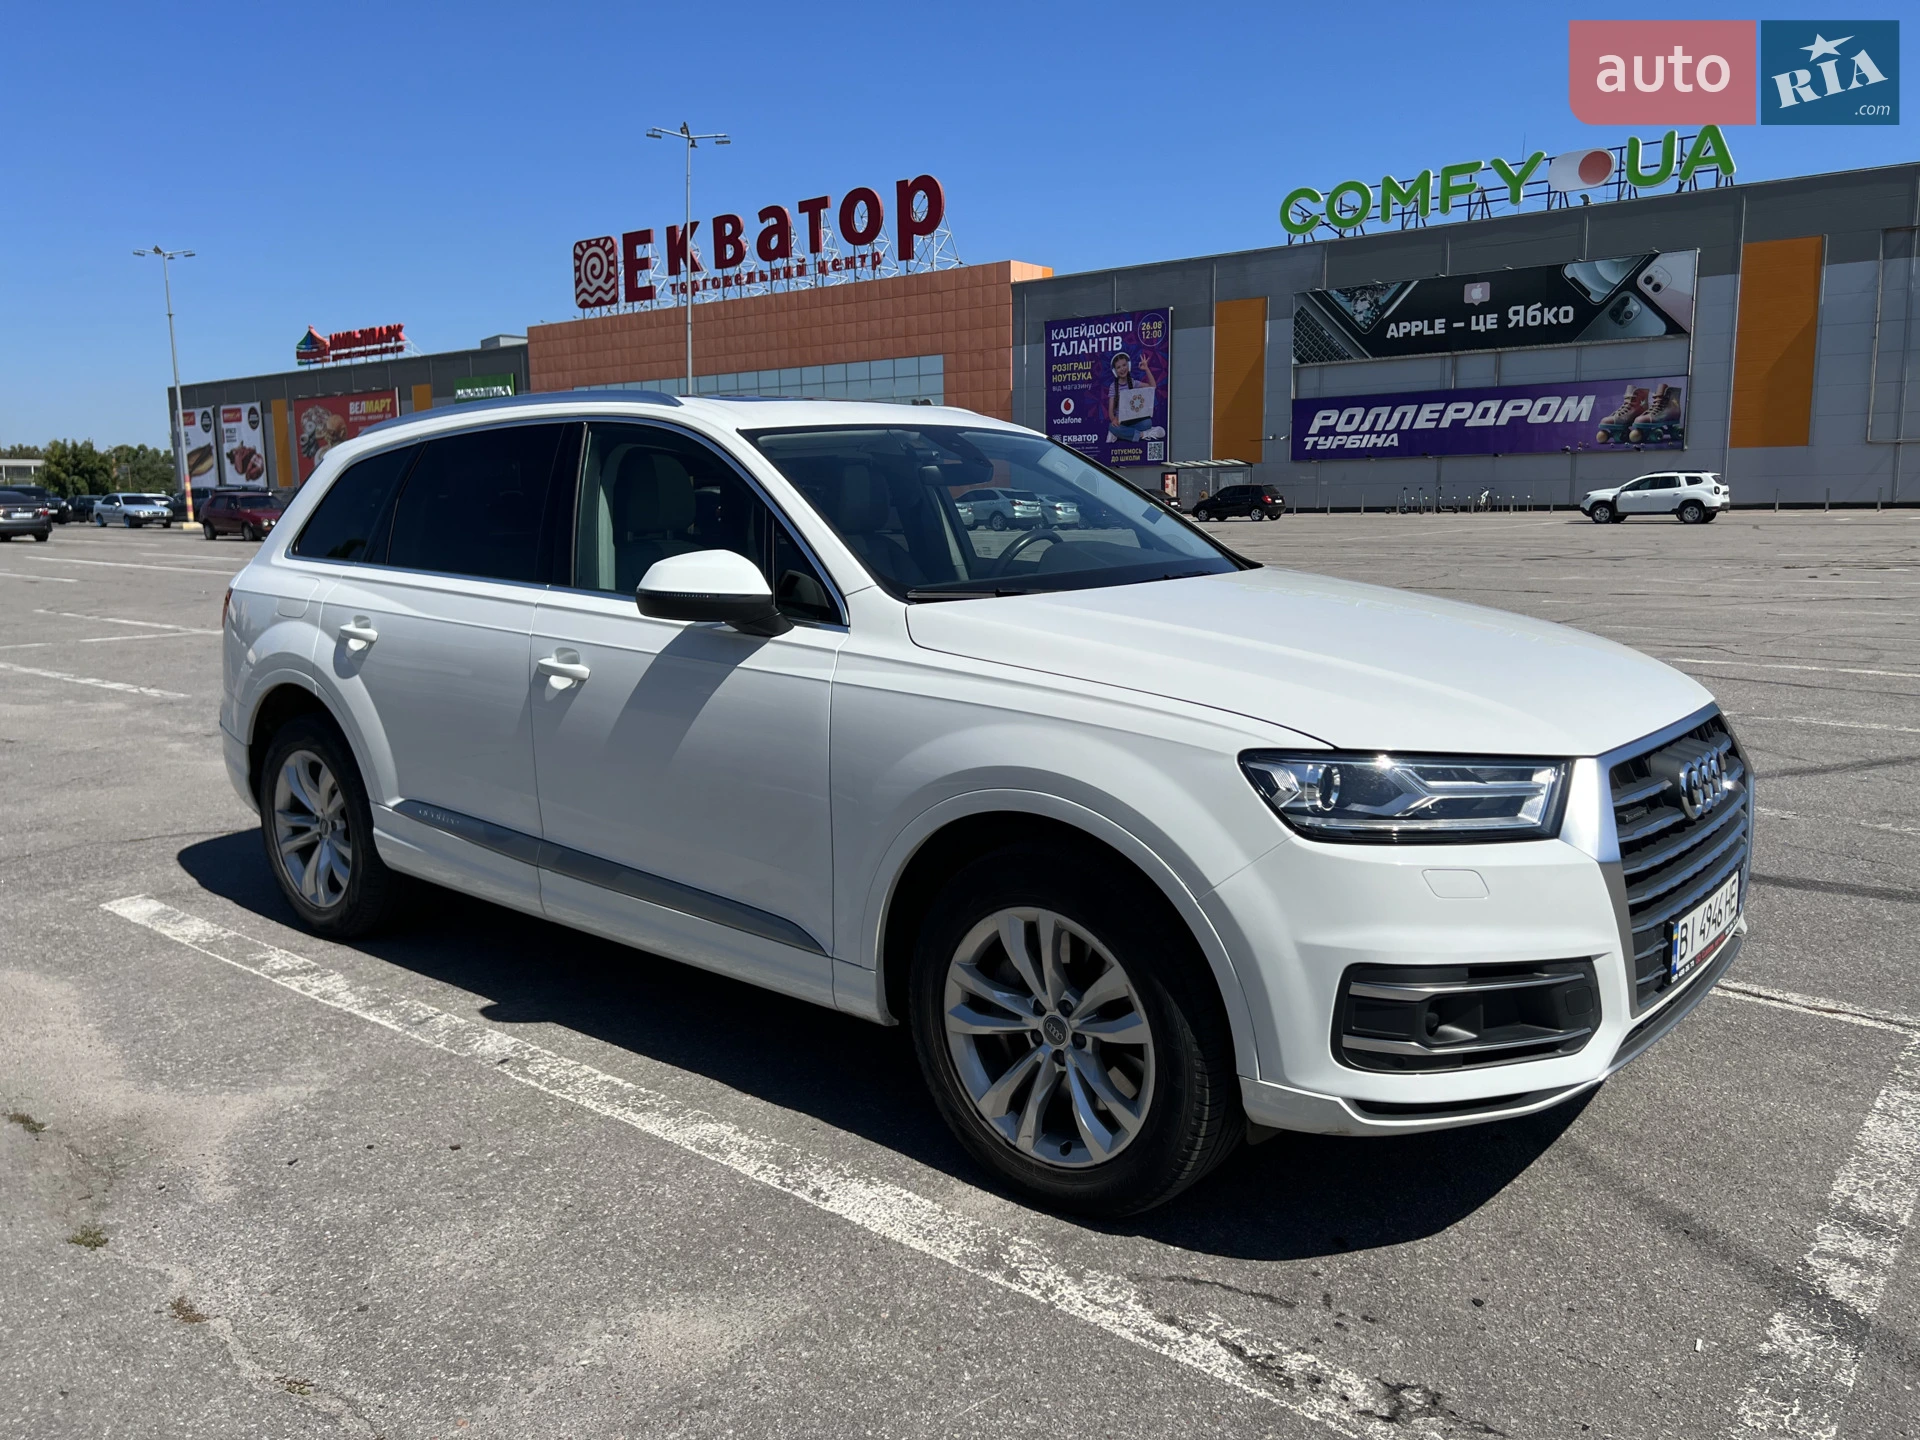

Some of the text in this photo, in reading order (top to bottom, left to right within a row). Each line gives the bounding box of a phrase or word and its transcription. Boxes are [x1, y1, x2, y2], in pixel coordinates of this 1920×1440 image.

[1279, 124, 1737, 237] COMFY UA
[669, 249, 883, 296] торговельний центр
[1386, 318, 1446, 339] APPLE
[1470, 313, 1499, 333] ЦЕ
[1507, 302, 1574, 329] Ябко
[1051, 320, 1133, 341] КАЛЕЙДОСКОП
[1141, 329, 1163, 340] 12:00
[1051, 335, 1123, 357] ТАЛАНТІВ
[1052, 371, 1092, 383] НОУТБУКА
[1052, 382, 1093, 392] від магазину
[349, 398, 392, 415] ВЕЛМАРТ
[1307, 394, 1597, 435] РОЛЛЕРДРОМ
[1053, 416, 1082, 425] vodafone
[1303, 432, 1400, 451] ТУРБІНА
[1111, 448, 1143, 456] ГОТУЄМОСЬ
[1111, 454, 1141, 463] ДО ШКОЛИ
[1699, 891, 1724, 942] 4946
